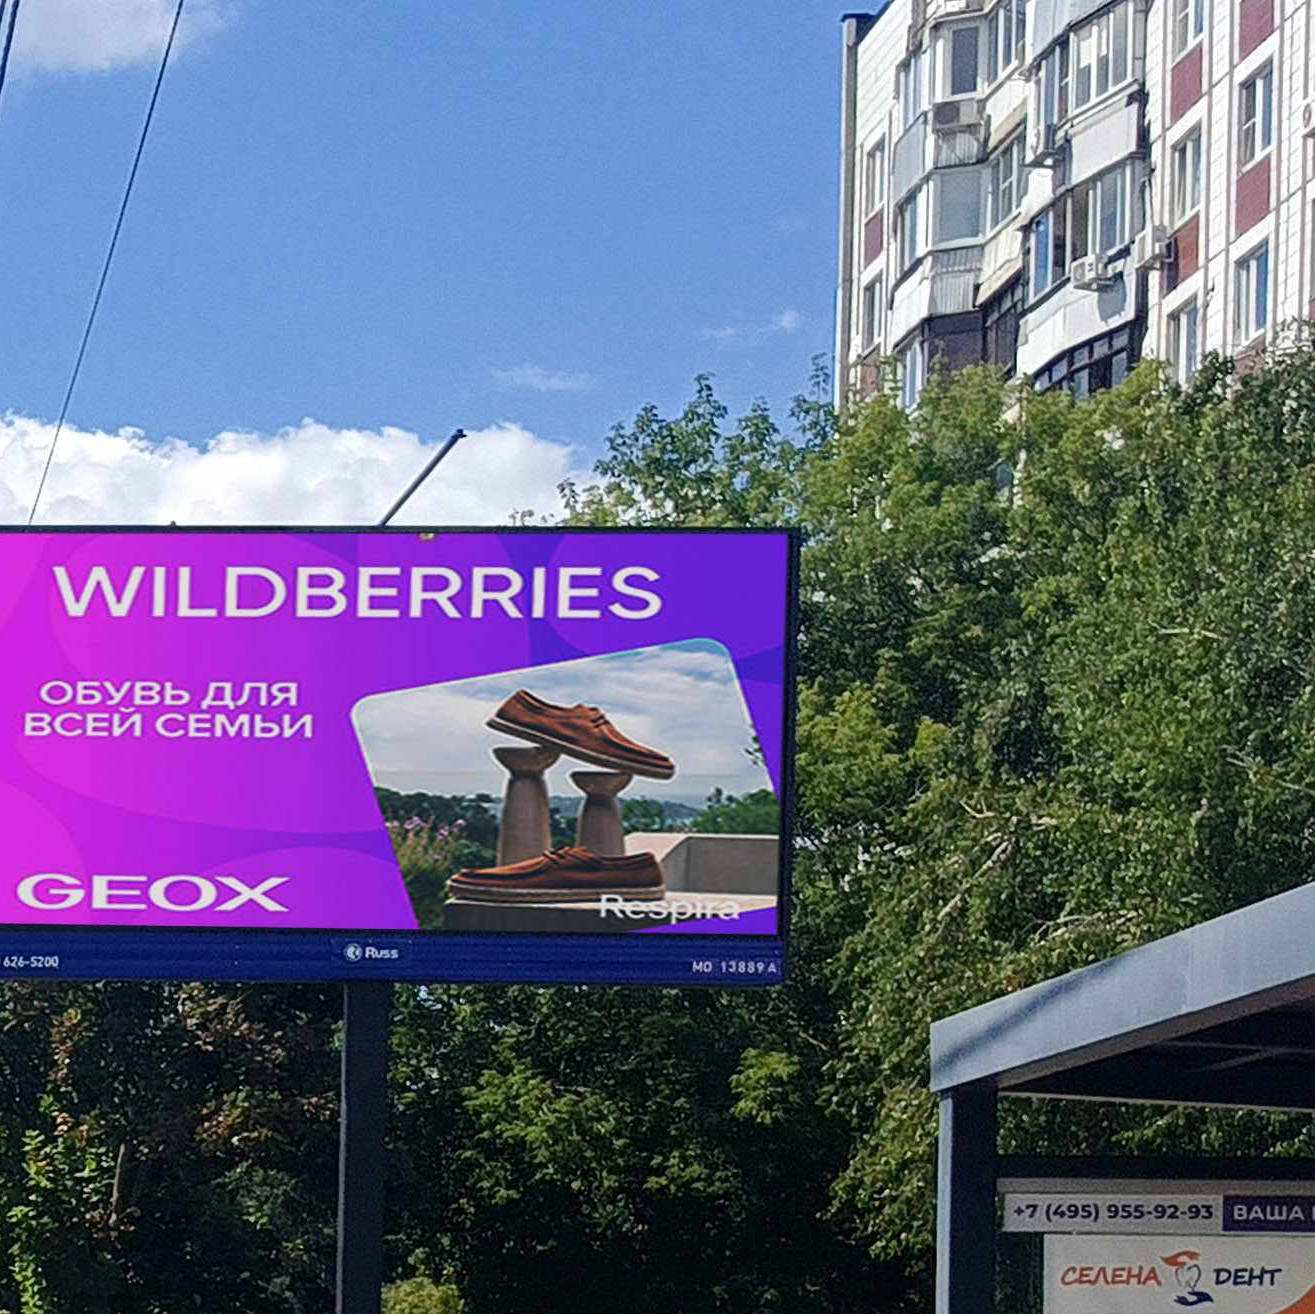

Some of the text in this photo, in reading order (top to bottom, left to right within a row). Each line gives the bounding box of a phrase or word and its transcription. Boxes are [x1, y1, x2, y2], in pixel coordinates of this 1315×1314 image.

[53, 565, 664, 620] WILDBERRIES
[39, 681, 299, 710] ОБУВЬ ДЛЯ
[23, 708, 312, 739] ВСЕЙ СЕМЬИ
[16, 874, 289, 912] GEOX
[600, 894, 740, 925] Respira
[3, 955, 59, 968] 626-5200
[365, 946, 399, 959] Russ
[721, 961, 765, 974] 13889
[1014, 1203, 1213, 1222] +7 (495) 955-92-93
[1233, 1205, 1305, 1220] ВАША
[1060, 1265, 1163, 1286] СЕЛЕНА
